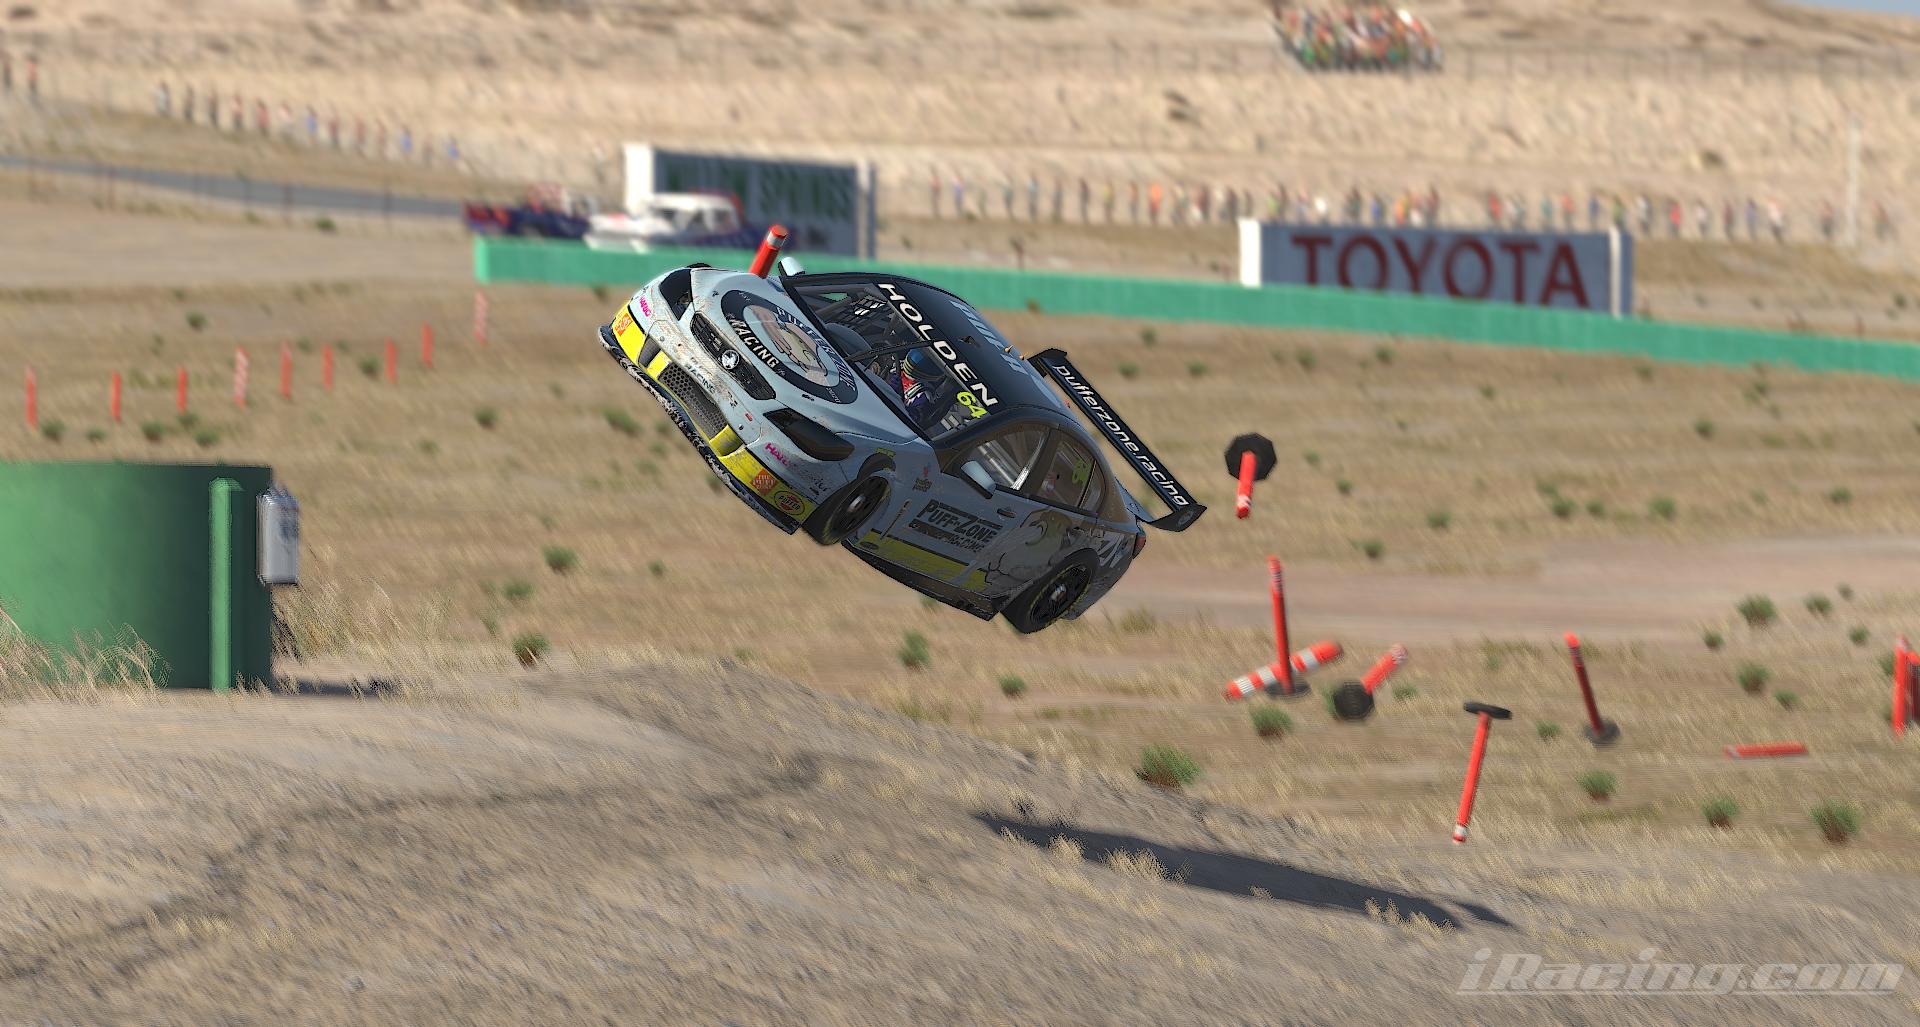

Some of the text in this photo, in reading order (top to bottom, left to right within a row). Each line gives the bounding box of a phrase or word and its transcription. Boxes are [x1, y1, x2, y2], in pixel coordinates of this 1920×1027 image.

[1291, 234, 1590, 307] TOYOTA
[729, 316, 780, 369] RACING
[878, 283, 998, 407] HOLDEN
[956, 391, 988, 420] 64
[1052, 365, 1190, 507] pufferzone.racing
